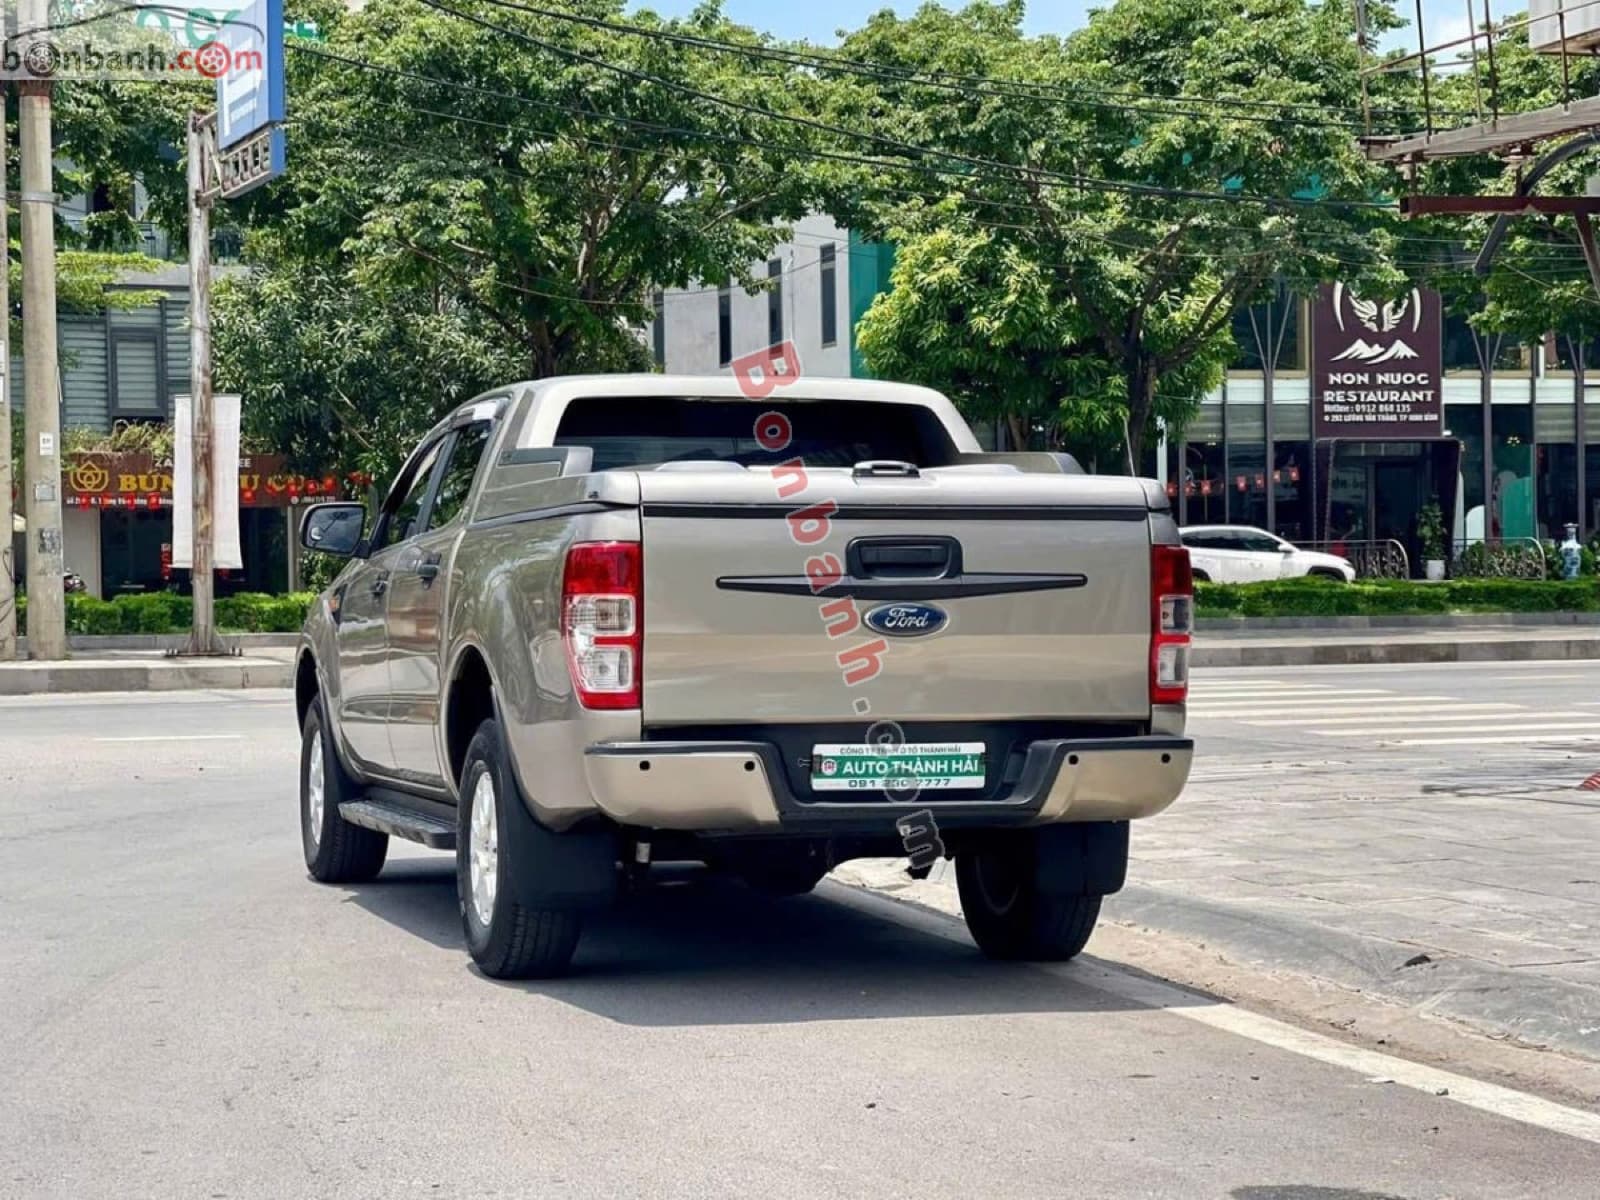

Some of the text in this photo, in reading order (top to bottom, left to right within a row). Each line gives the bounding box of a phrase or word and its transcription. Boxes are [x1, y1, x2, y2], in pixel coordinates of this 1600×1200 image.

[1328, 373, 1369, 385] NON
[1323, 390, 1434, 402] RESTAURANT
[1355, 404, 1376, 413] 0912
[885, 608, 928, 627] Ford
[842, 756, 979, 774] AUTO THÀNH HẢI
[848, 779, 876, 788] 091
